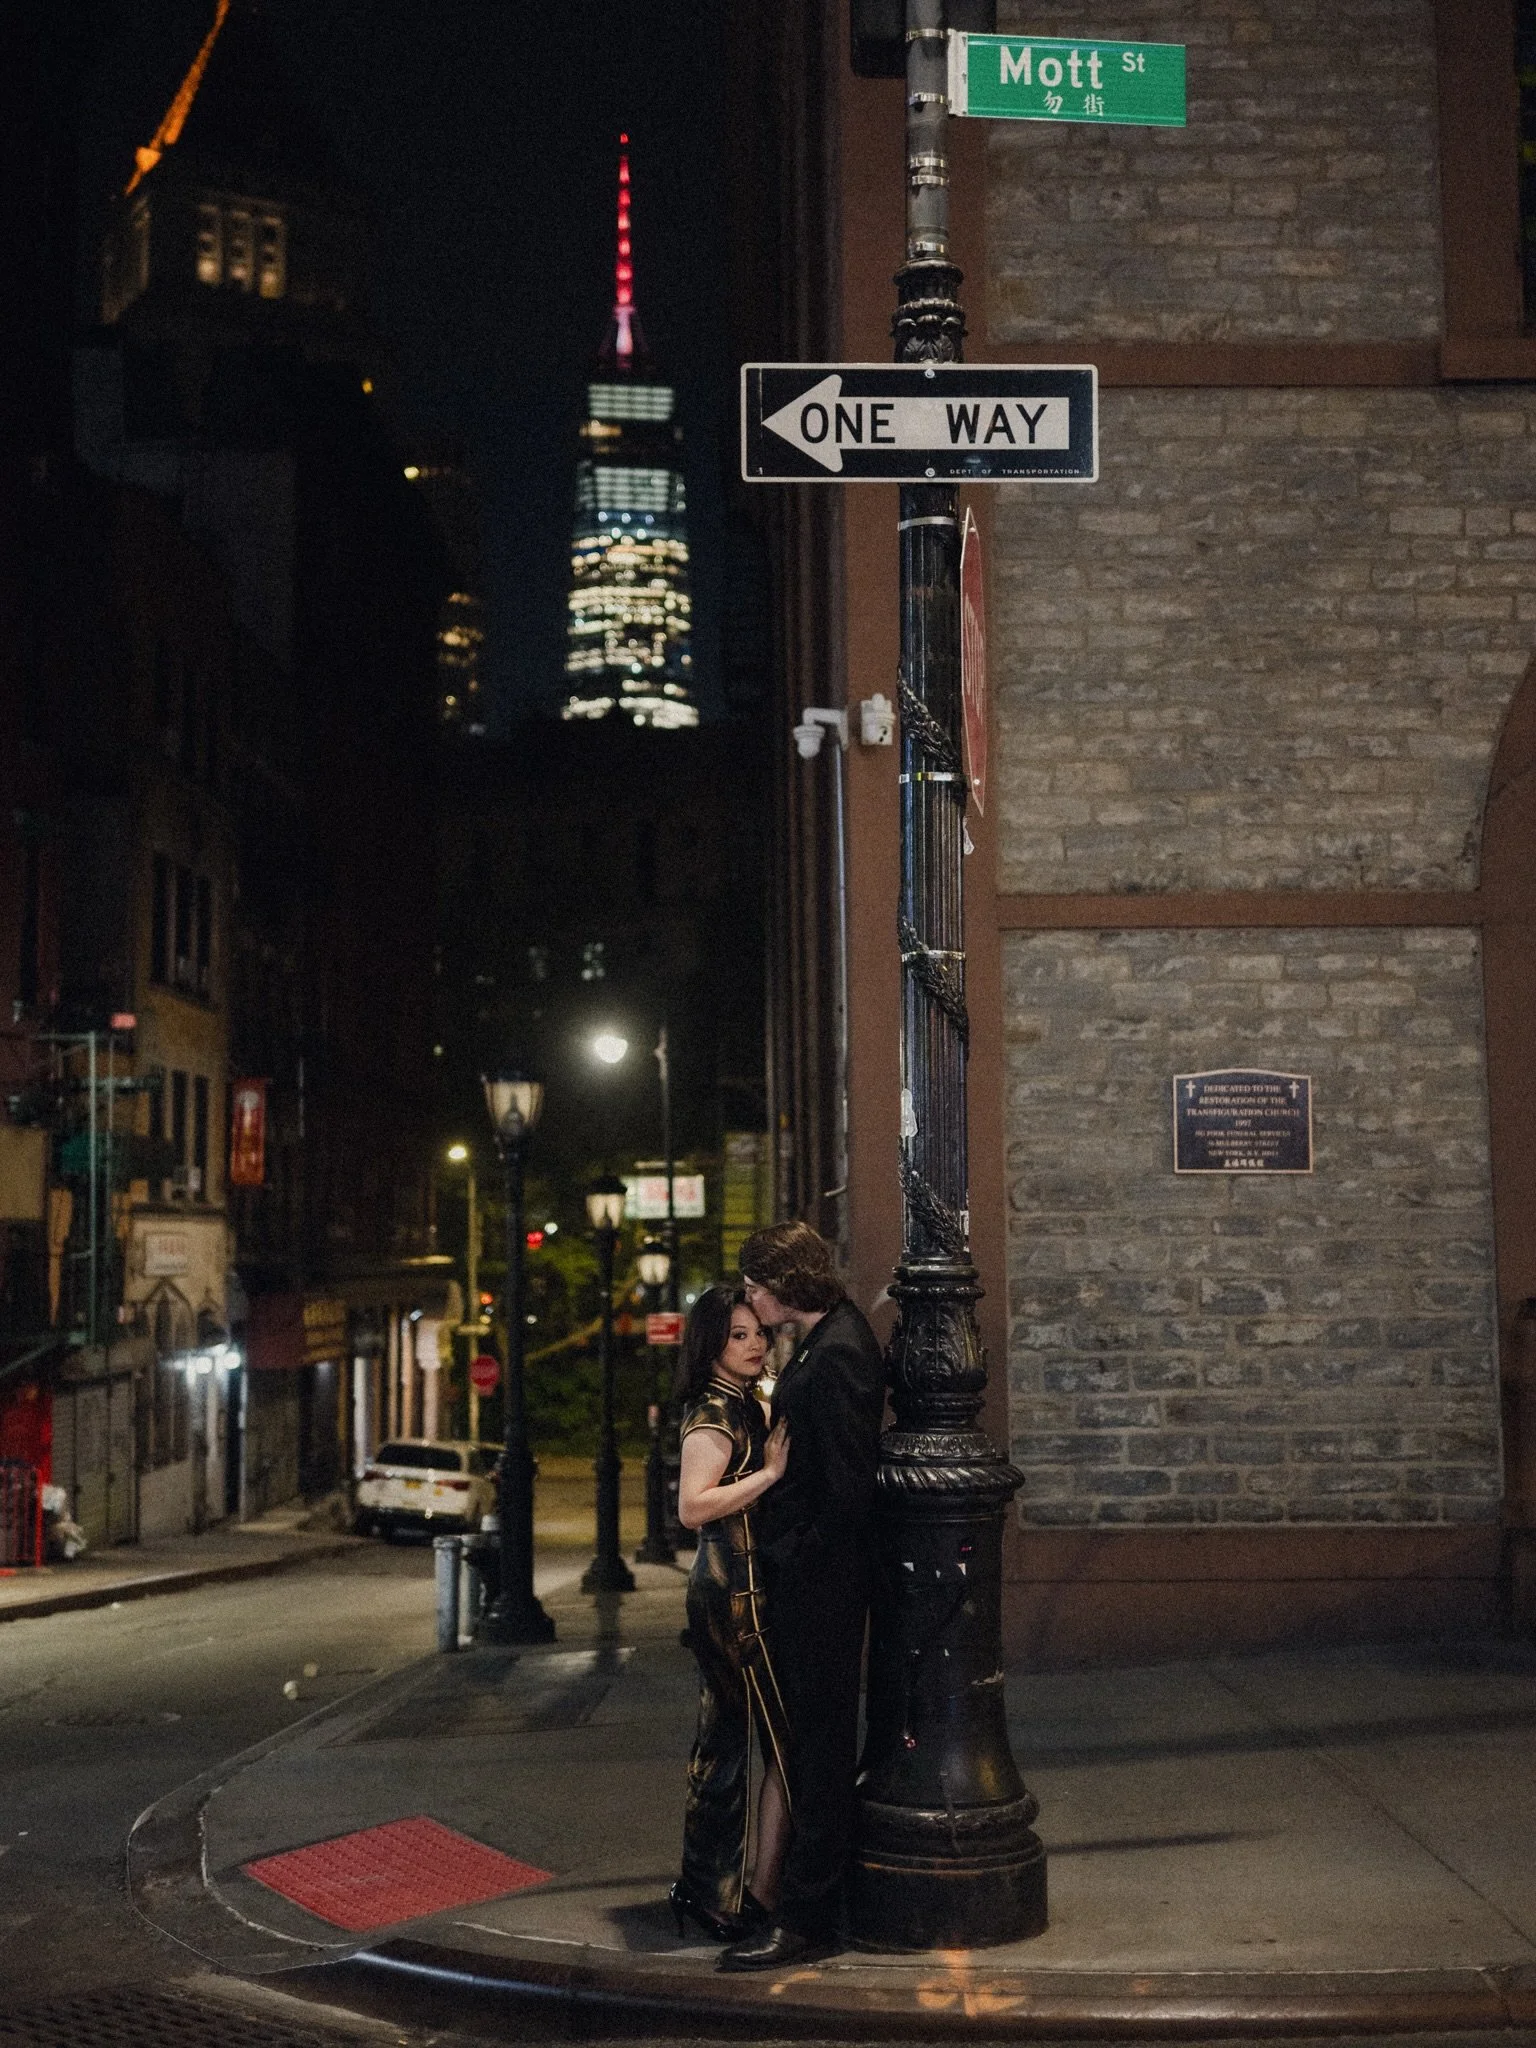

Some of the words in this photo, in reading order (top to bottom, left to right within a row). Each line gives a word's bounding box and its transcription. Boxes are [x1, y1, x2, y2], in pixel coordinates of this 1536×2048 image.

[1000, 45, 1103, 90] Mott
[1122, 52, 1146, 73] St
[1043, 91, 1105, 116] 勿街
[800, 402, 896, 444] ONE
[945, 403, 1048, 444] WAY
[1204, 1084, 1251, 1093] DEDICATED
[1252, 1084, 1264, 1093] TO
[1265, 1084, 1281, 1093] THE
[1199, 1096, 1256, 1104] RESTORATION
[1257, 1096, 1267, 1104] OF
[1271, 1096, 1287, 1104] THE
[1187, 1108, 1263, 1116] TRANSFIGURATION
[1265, 1108, 1300, 1116] CHURCH
